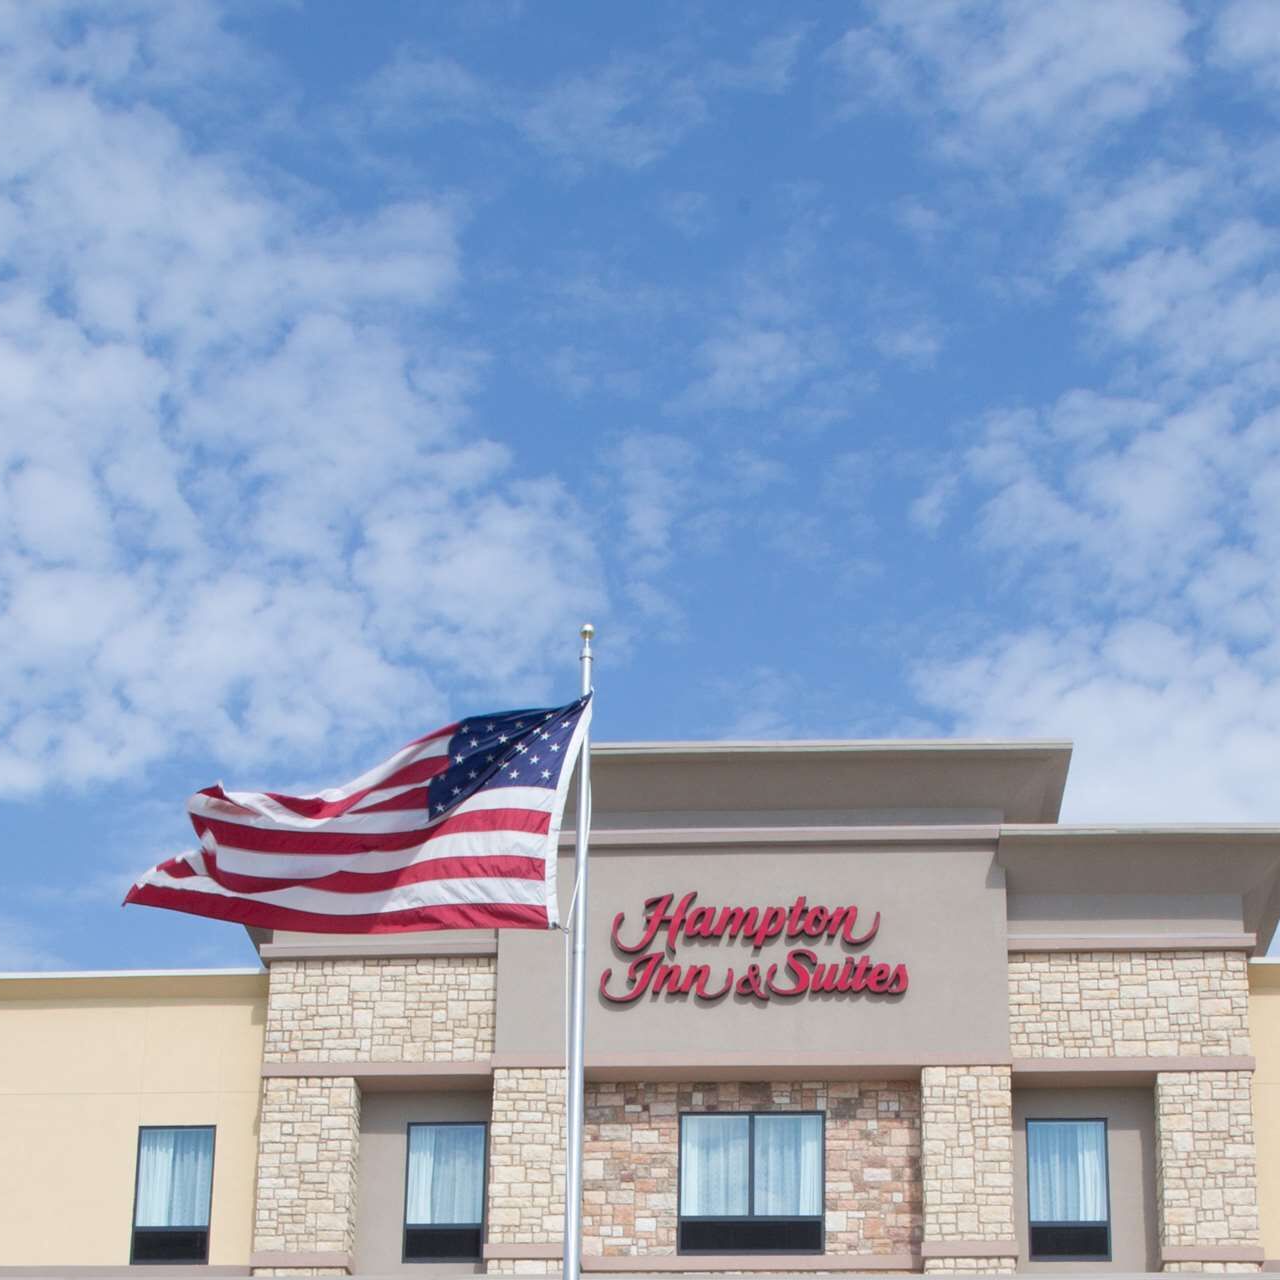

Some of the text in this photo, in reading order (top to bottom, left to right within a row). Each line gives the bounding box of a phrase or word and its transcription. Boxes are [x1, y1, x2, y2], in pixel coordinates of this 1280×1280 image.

[611, 891, 880, 953] Hampton
[601, 949, 908, 1001] Inn & Suites
